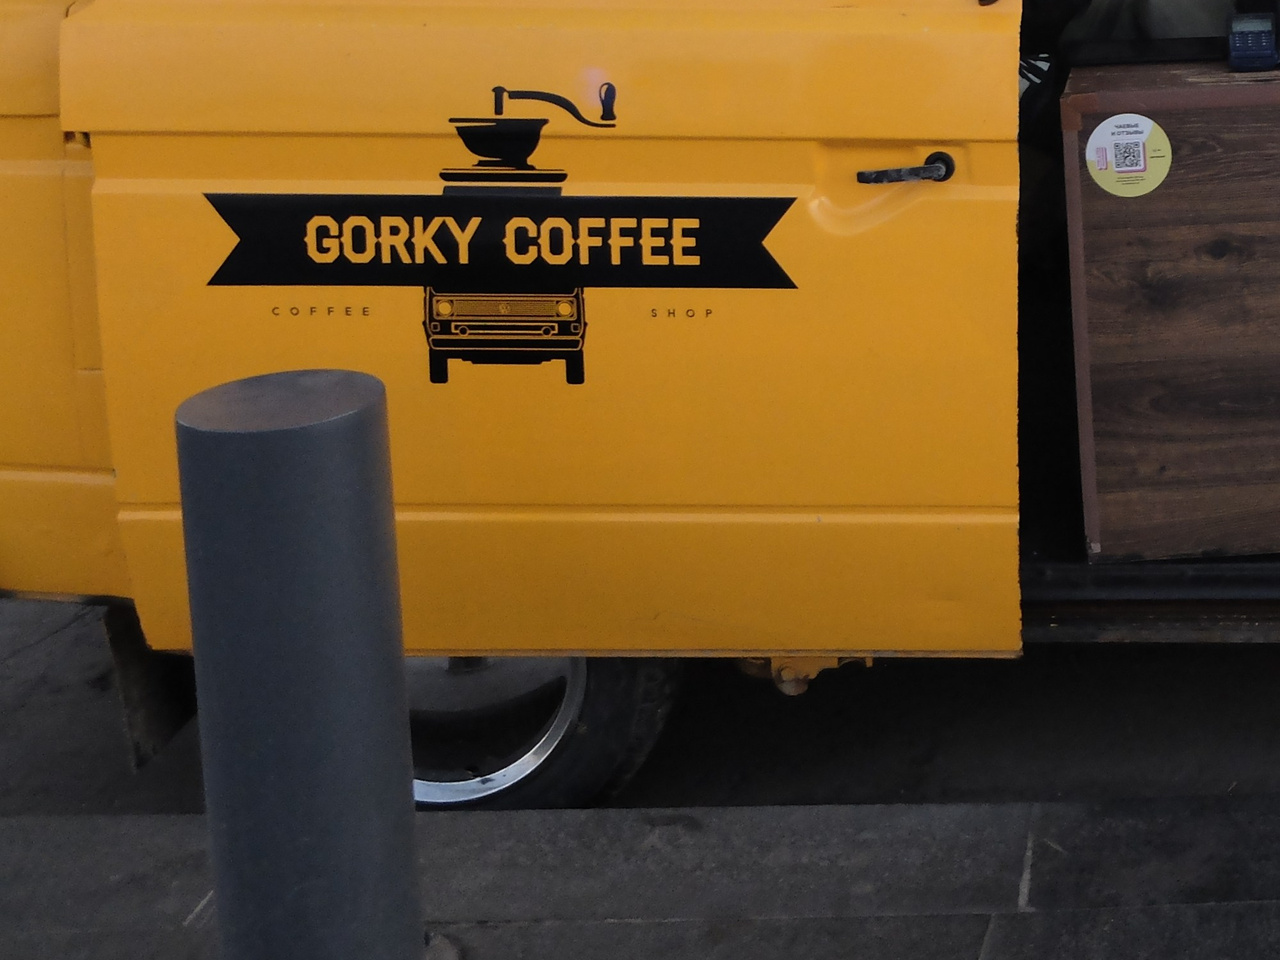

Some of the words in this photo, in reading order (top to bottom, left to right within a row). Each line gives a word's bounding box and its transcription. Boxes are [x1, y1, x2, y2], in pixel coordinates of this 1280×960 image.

[304, 215, 483, 265] GORKY
[502, 216, 701, 267] COFFEE
[271, 306, 370, 316] COFFEE
[651, 308, 713, 318] SHOP
